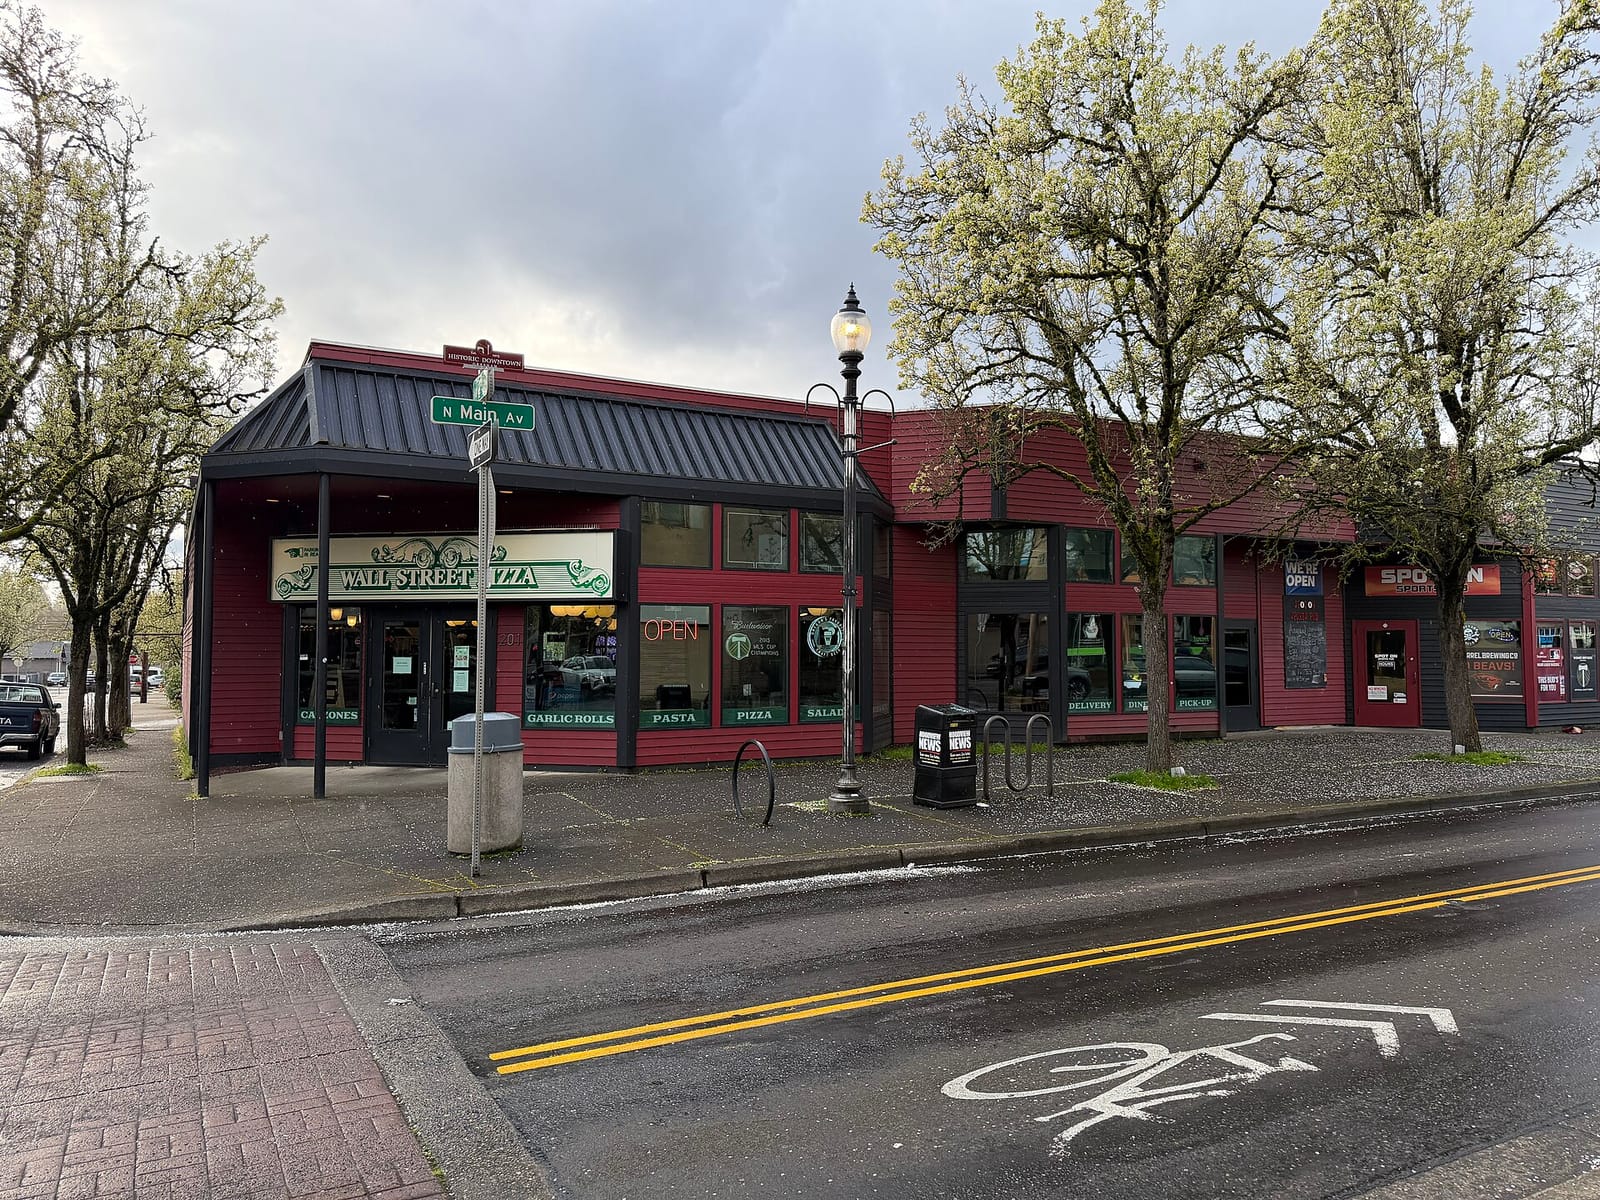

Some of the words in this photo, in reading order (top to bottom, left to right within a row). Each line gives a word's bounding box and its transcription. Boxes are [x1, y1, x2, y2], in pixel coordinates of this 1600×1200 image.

[448, 353, 480, 363] HISTORIC
[482, 357, 521, 367] DOWNTOWN
[443, 406, 452, 418] N
[460, 404, 497, 421] Main
[506, 412, 524, 424] Av
[340, 569, 391, 590] WALL
[396, 568, 473, 590] STREET
[478, 566, 538, 588] IZZA
[1286, 574, 1316, 587] OPEN
[1381, 569, 1428, 584] SPO
[644, 619, 699, 641] OPEN
[500, 633, 521, 646] 201
[1473, 661, 1515, 671] BEAVS!
[1068, 701, 1112, 710] DELIVERY
[1179, 699, 1212, 707] PICK-UP
[300, 711, 359, 720] CAONES
[527, 714, 573, 724] GARLIC
[574, 715, 615, 724] ROLLS
[653, 713, 696, 723] PASTA
[737, 711, 773, 720] PIZZA
[807, 708, 844, 717] SALAD
[919, 737, 941, 753] NEWS
[949, 736, 972, 750] NEWS
